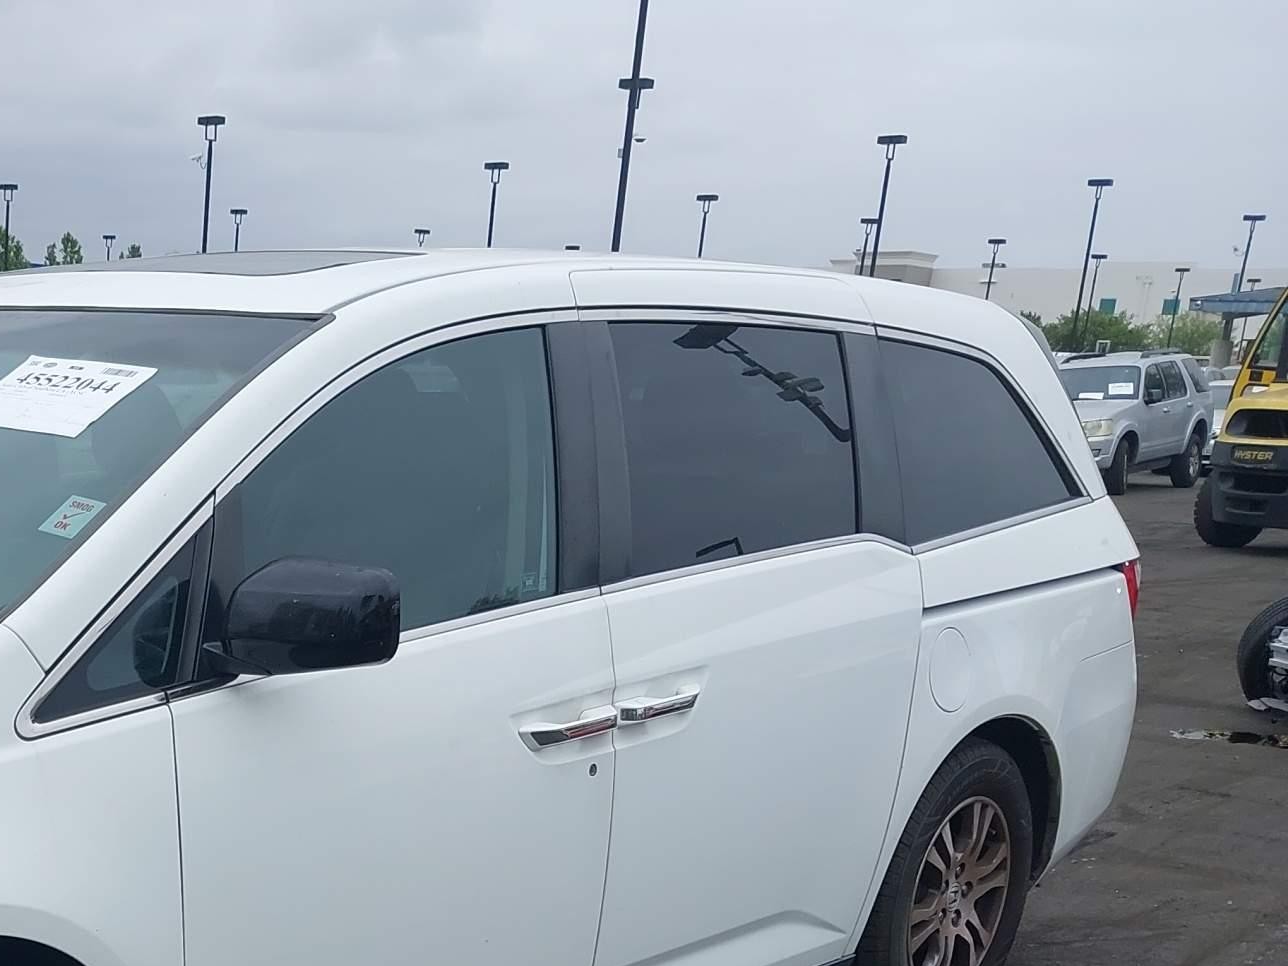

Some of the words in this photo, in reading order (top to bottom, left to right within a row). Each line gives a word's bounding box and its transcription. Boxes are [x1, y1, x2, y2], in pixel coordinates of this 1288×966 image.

[16, 372, 121, 395] 45522044
[1233, 449, 1274, 461] HYSTER
[68, 500, 95, 513] SMOG
[54, 520, 72, 531] OK
